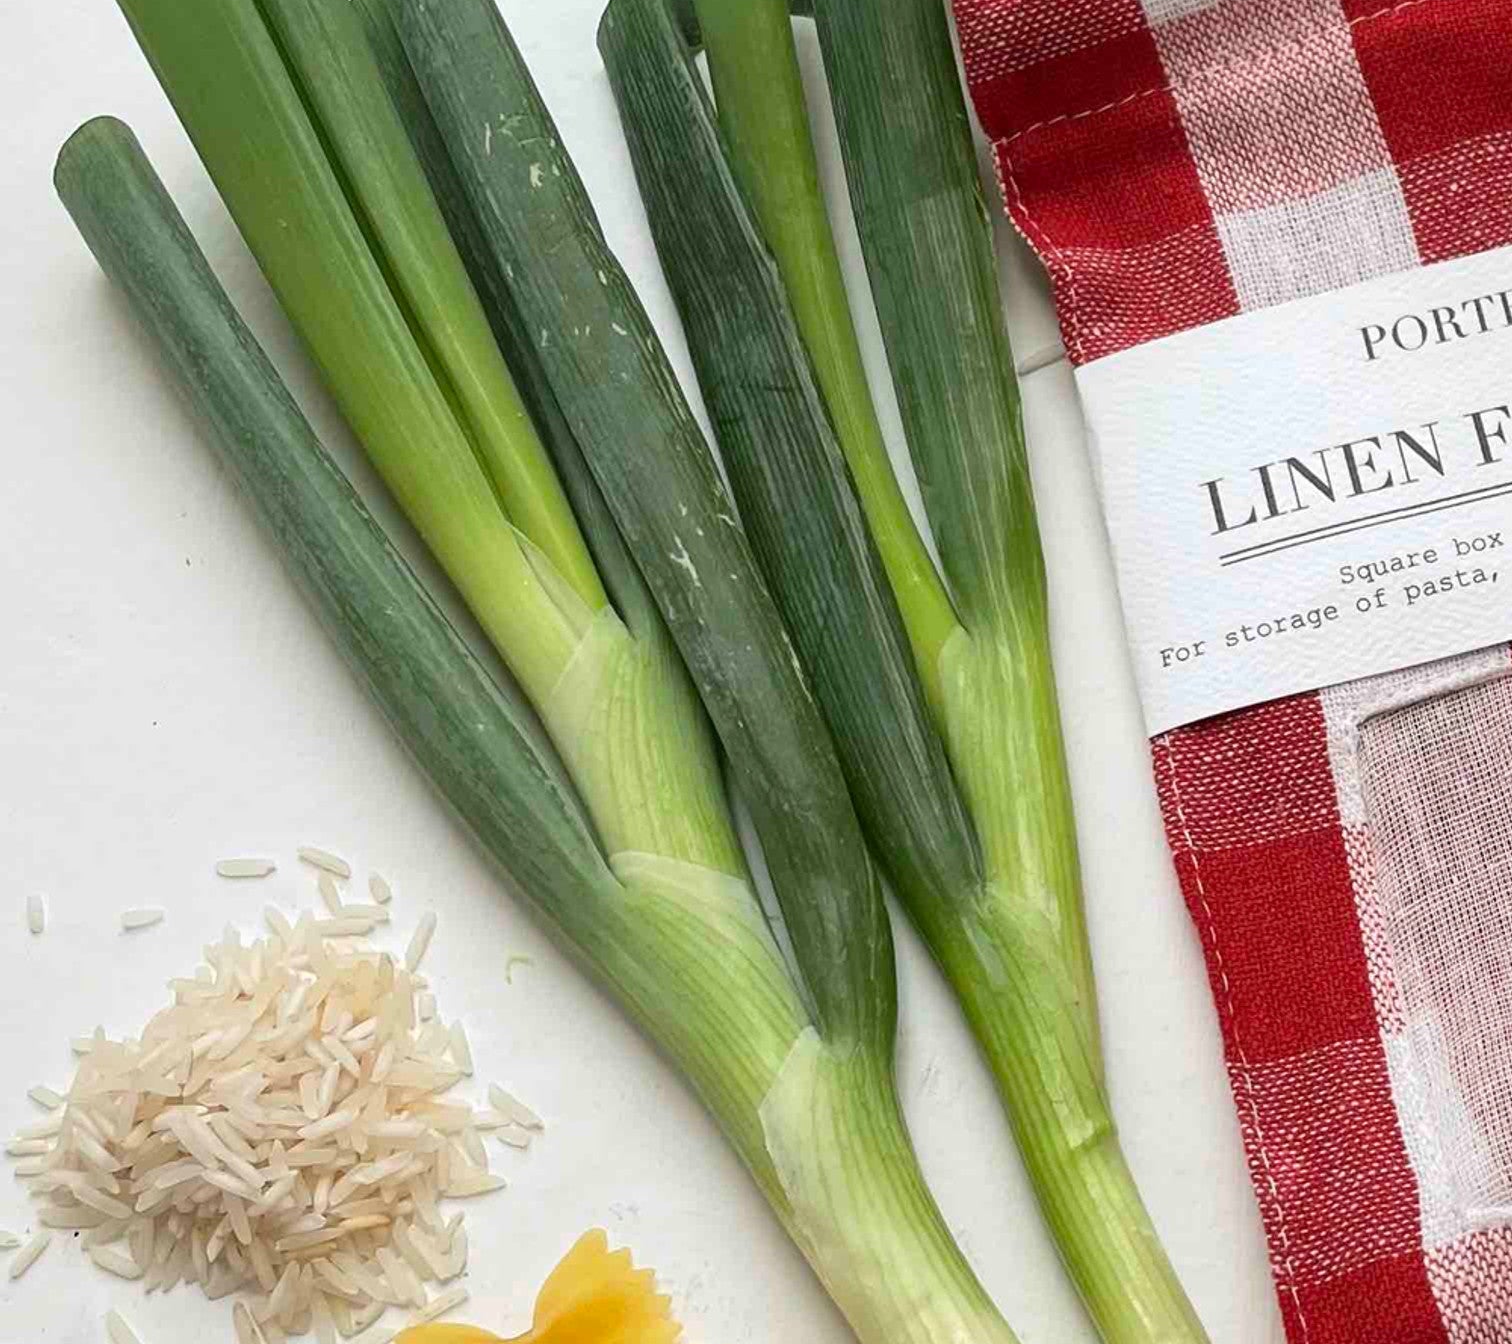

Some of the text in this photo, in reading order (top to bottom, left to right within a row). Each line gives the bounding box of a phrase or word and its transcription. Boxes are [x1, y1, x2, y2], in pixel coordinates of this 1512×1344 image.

[1198, 419, 1447, 537] LINEN
[1338, 547, 1440, 586] Square
[1450, 531, 1506, 558] box
[1158, 639, 1207, 669] For
[1223, 604, 1340, 649] storage
[1354, 586, 1389, 614] of
[1402, 567, 1500, 607] pasta,
